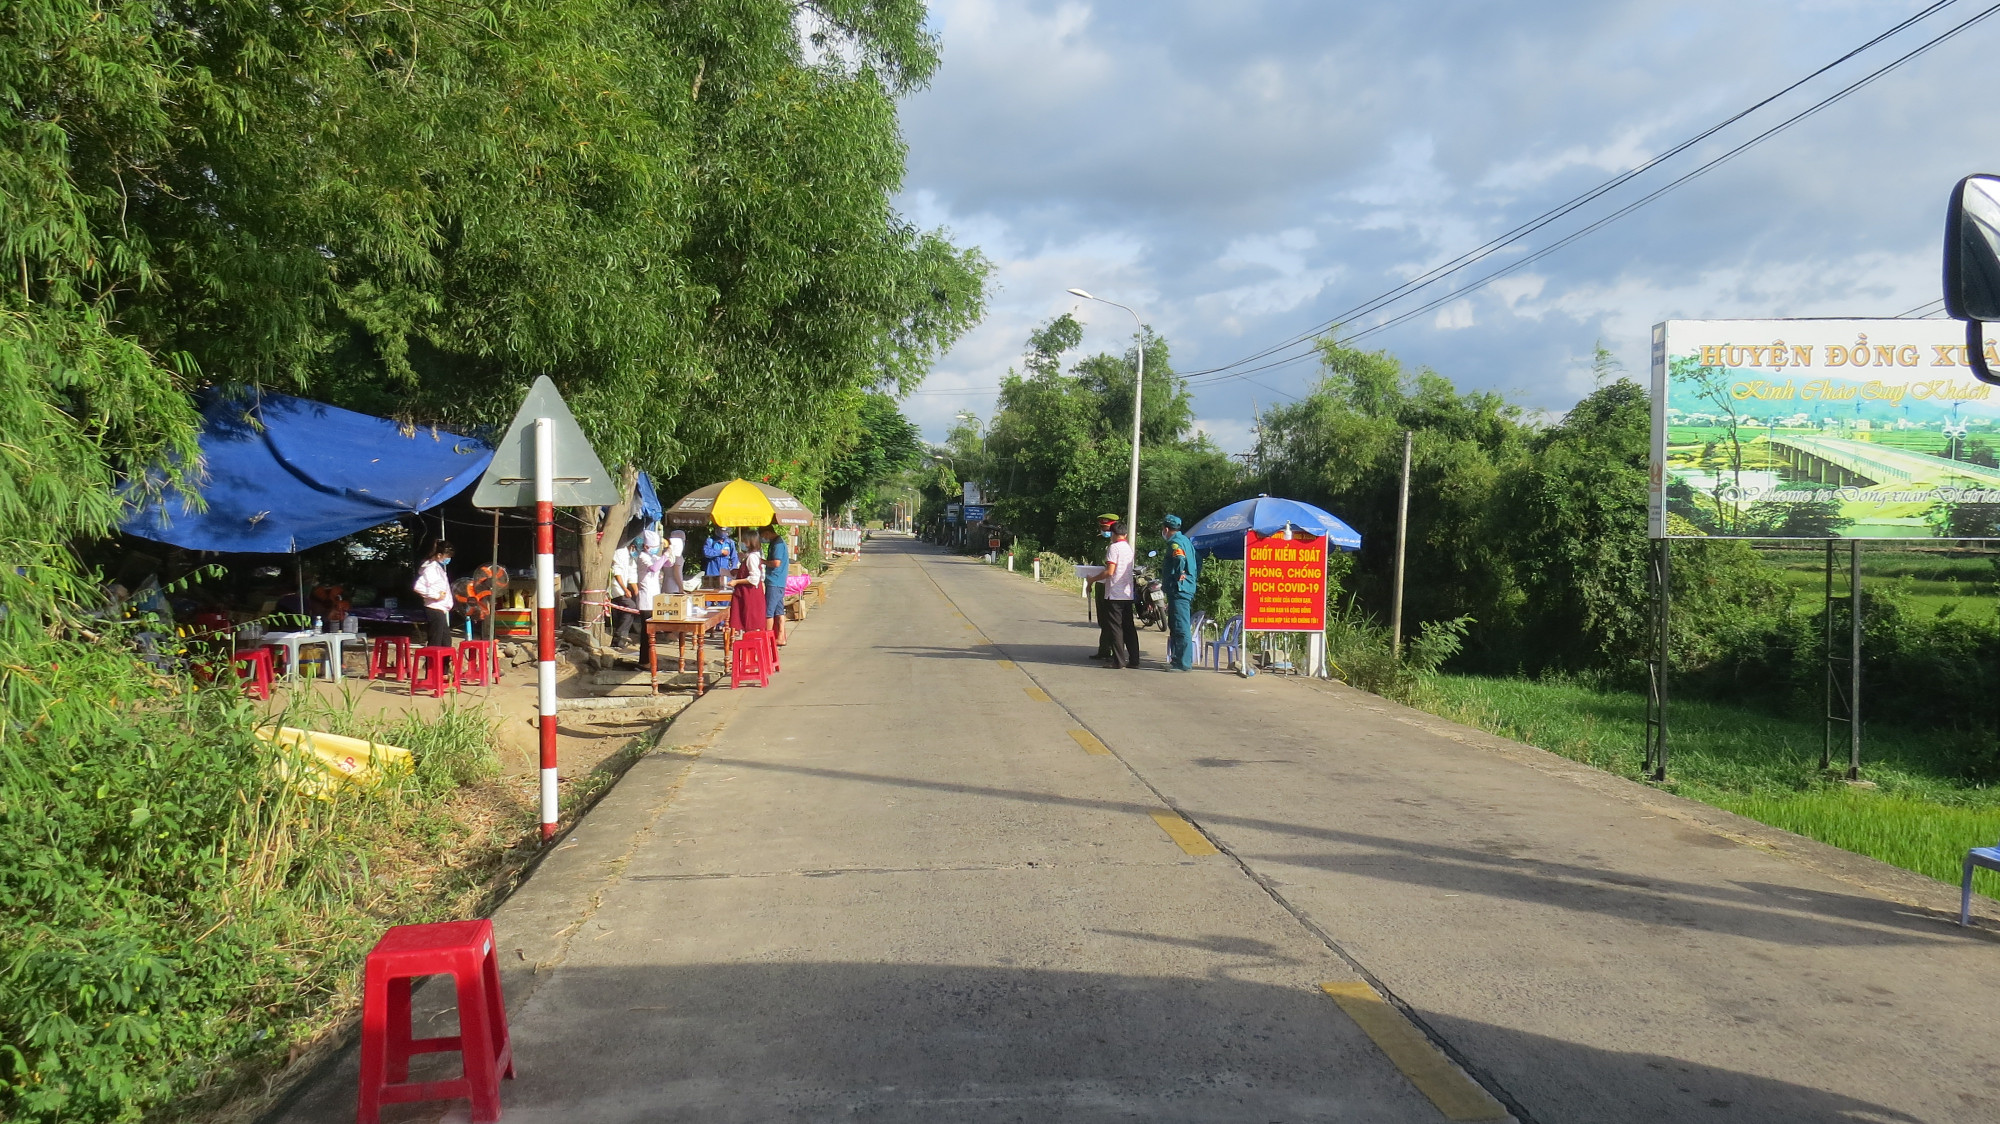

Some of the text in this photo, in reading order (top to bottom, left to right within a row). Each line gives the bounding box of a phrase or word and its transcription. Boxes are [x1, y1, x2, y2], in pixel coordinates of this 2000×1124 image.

[1699, 339, 1814, 372] HUYỆN
[1824, 332, 1920, 367] ĐỒNG
[1731, 379, 1796, 400] Kính
[1910, 379, 1991, 400] Khách
[1723, 486, 1812, 502] Welcome
[1814, 488, 1832, 502] to
[1250, 543, 1321, 562] CHỐT KIỂM SOÁT
[1249, 563, 1322, 580] PHÒNG, CHỐNG
[1252, 582, 1319, 595] DỊCH COVID-19
